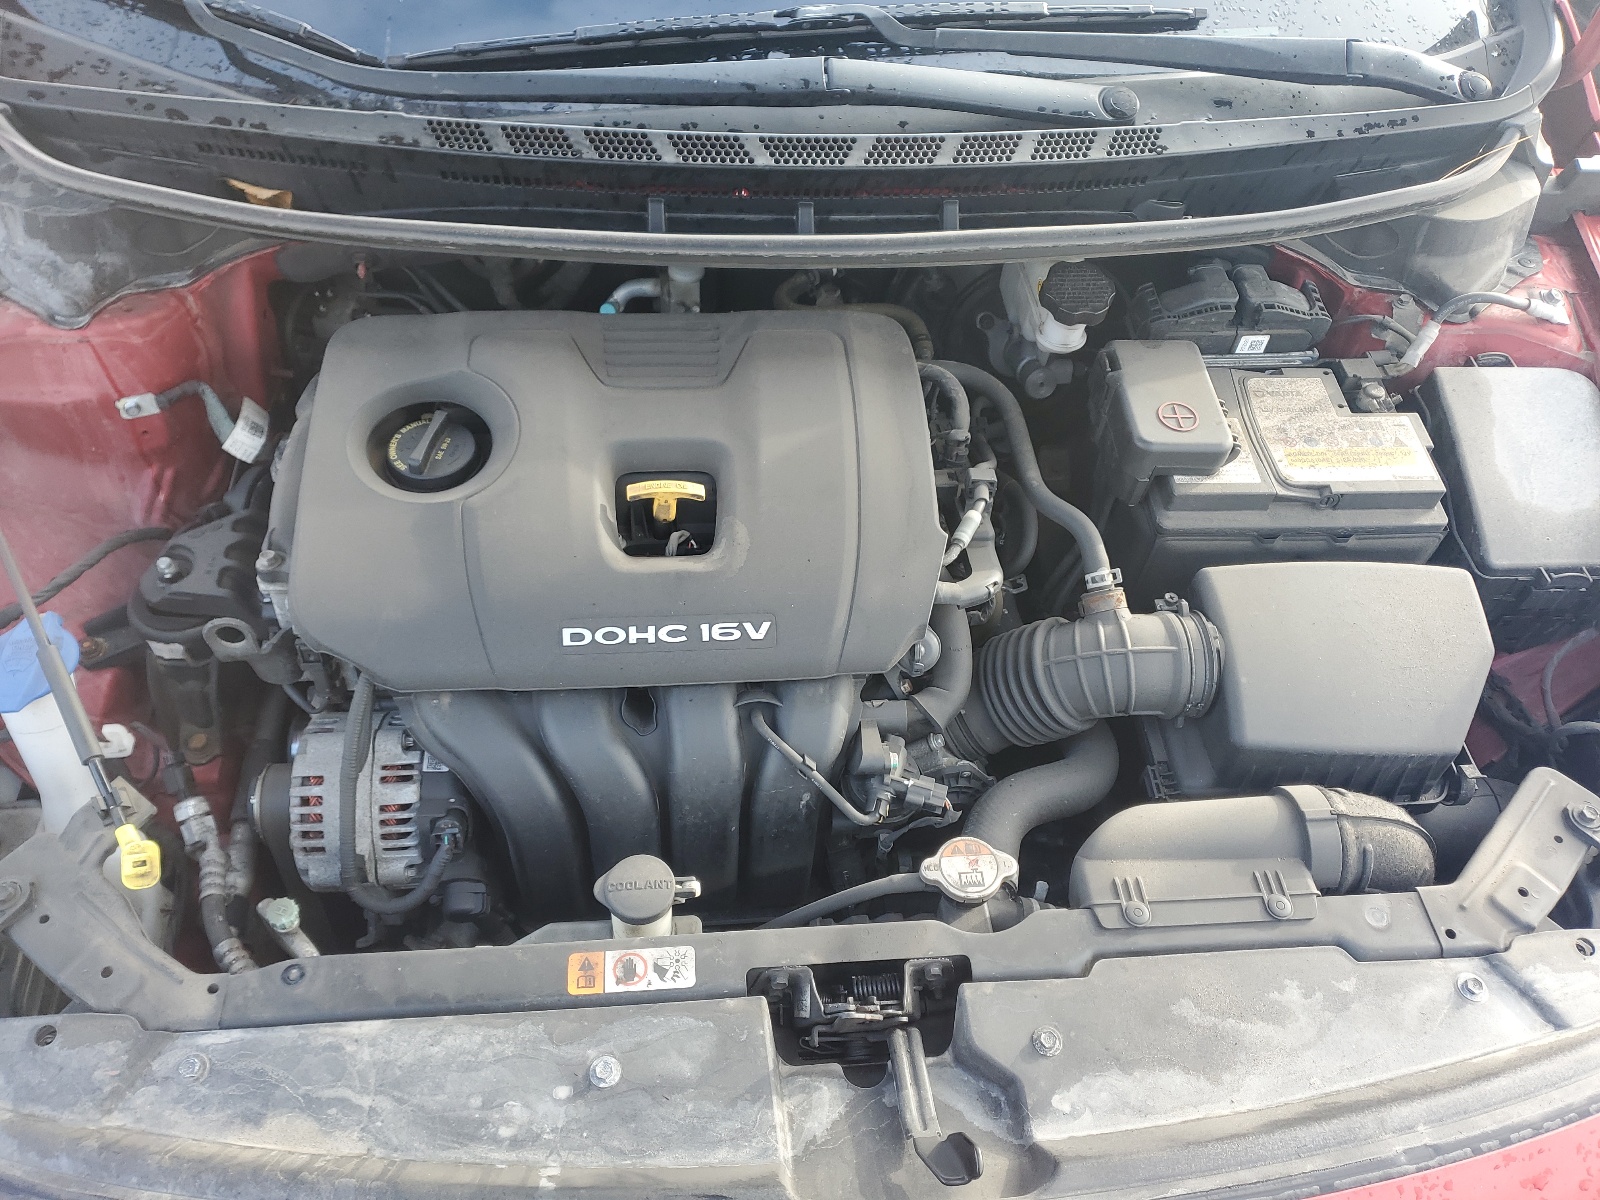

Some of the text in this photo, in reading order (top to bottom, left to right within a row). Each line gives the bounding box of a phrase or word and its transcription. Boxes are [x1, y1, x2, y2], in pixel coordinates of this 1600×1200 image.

[400, 419, 431, 434] MANUAL
[393, 459, 408, 471] SEE
[562, 621, 772, 646] DOHC 16V
[607, 879, 673, 893] COOLANT
